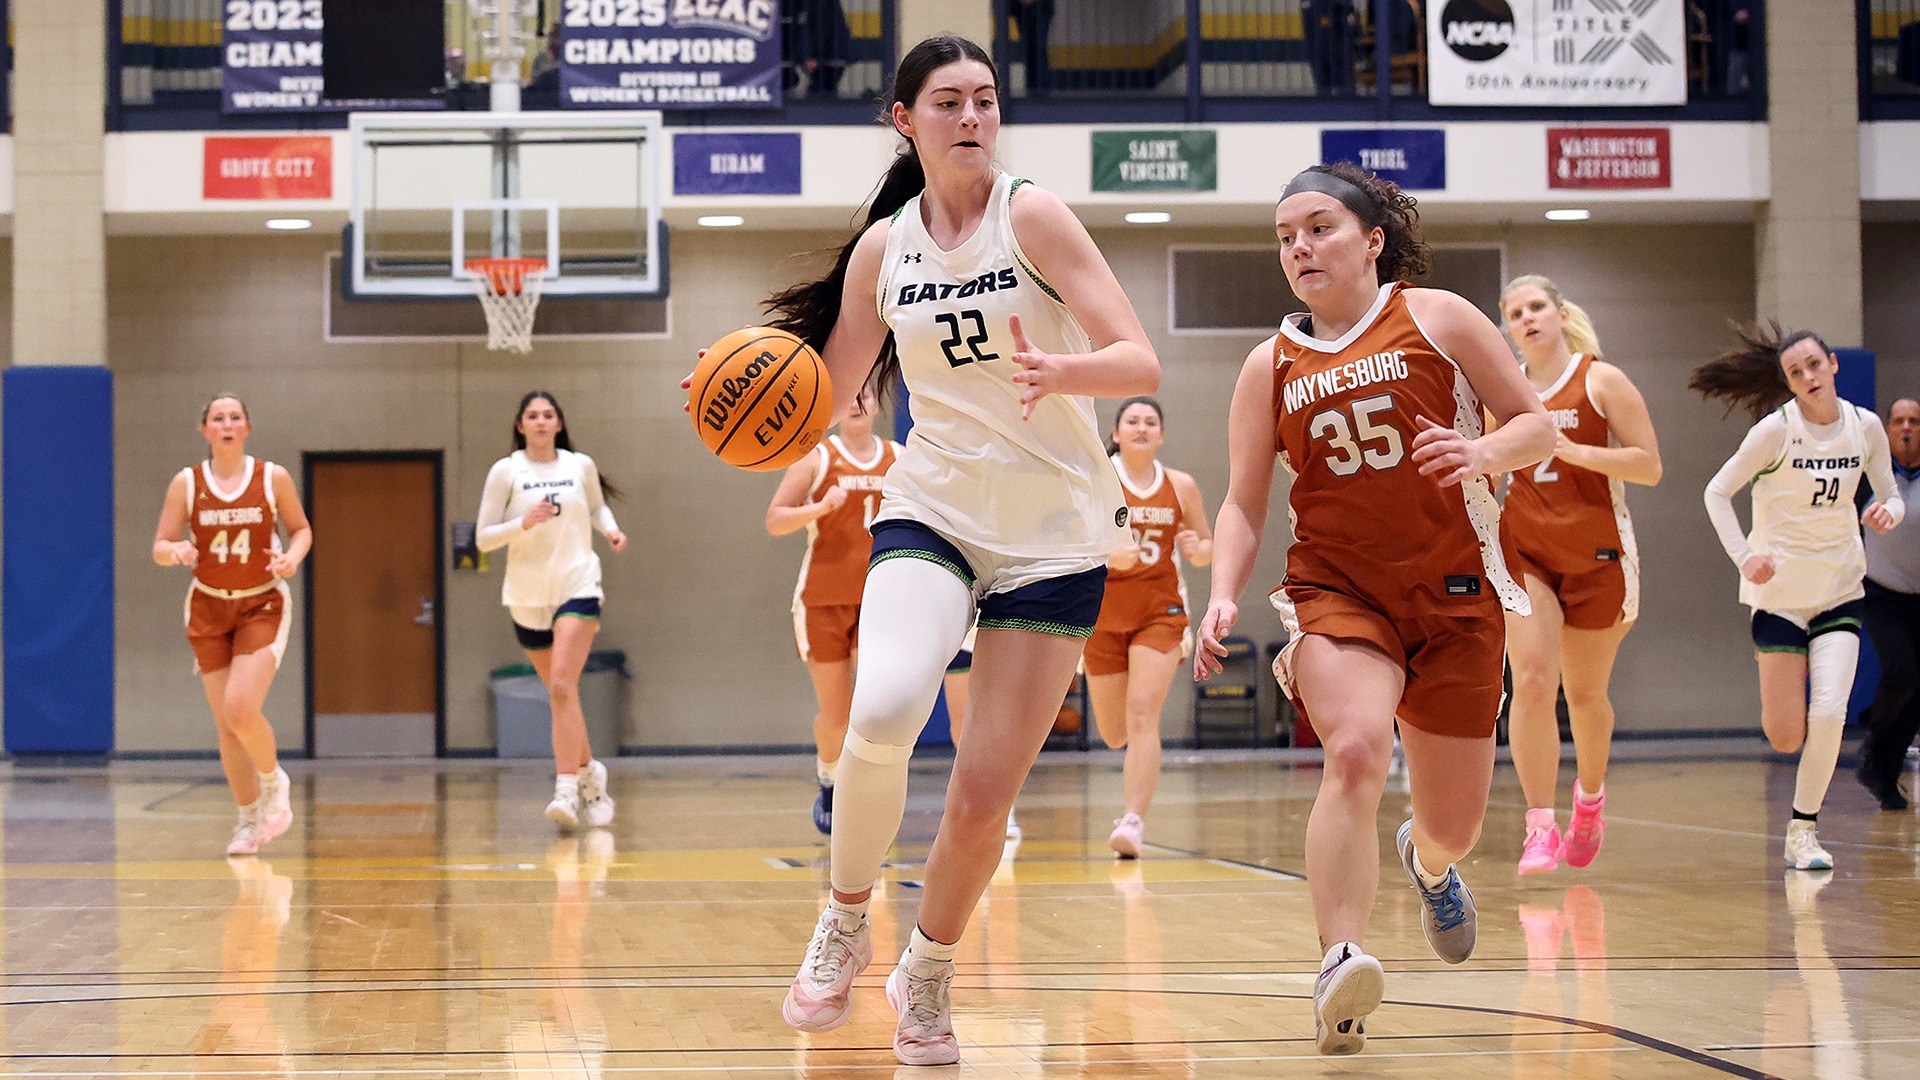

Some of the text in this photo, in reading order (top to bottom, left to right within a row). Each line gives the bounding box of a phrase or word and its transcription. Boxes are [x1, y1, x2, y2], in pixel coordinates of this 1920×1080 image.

[226, 0, 323, 30] 2023
[564, 0, 666, 27] 2025
[1556, 17, 1632, 34] TITLE
[1448, 20, 1513, 45] NCAA
[564, 38, 756, 64] CHAMPIONS
[569, 86, 772, 103] WOMEN'S BASKETBALL
[1521, 74, 1649, 92] Anniversary
[1128, 140, 1178, 160] SAINT
[1561, 137, 1657, 157] WASHINGTON
[1119, 160, 1189, 182] VINCENT
[1573, 158, 1660, 179] JEFFERSON
[897, 266, 1019, 307] GATORS
[934, 308, 1001, 369] 22
[703, 350, 779, 432] Wilson
[1283, 349, 1409, 416] WAYNESBURG
[1309, 391, 1406, 478] 35
[1791, 455, 1861, 470] GATORS
[523, 479, 575, 490] GATORS
[1811, 477, 1840, 506] 24
[198, 506, 264, 526] WAYNESBURG
[208, 528, 252, 565] 44
